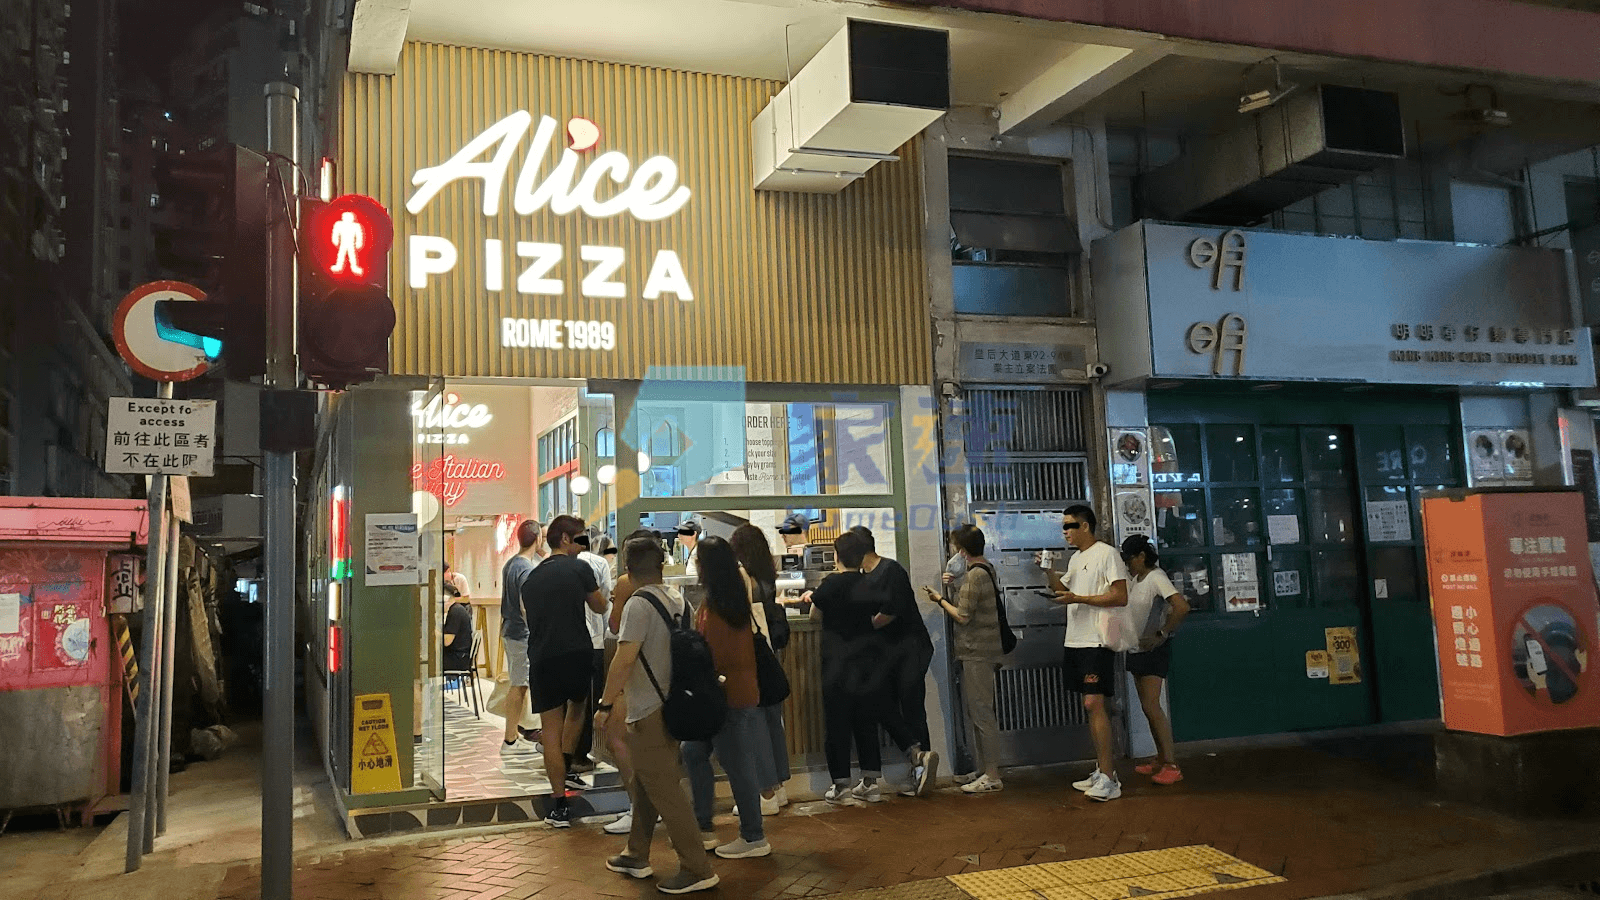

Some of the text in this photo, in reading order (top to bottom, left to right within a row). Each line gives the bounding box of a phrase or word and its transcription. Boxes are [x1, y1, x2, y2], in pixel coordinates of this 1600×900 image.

[406, 109, 691, 222] Alice
[409, 235, 694, 301] PIZZA
[502, 317, 615, 350] ROME 1989
[128, 402, 193, 415] Except fo
[139, 418, 185, 427] access
[741, 416, 768, 429] ORDER
[113, 431, 209, 448] 前往此區者
[417, 432, 470, 444] PIZZA
[122, 452, 198, 468] 不在此限
[427, 455, 504, 479] Italian
